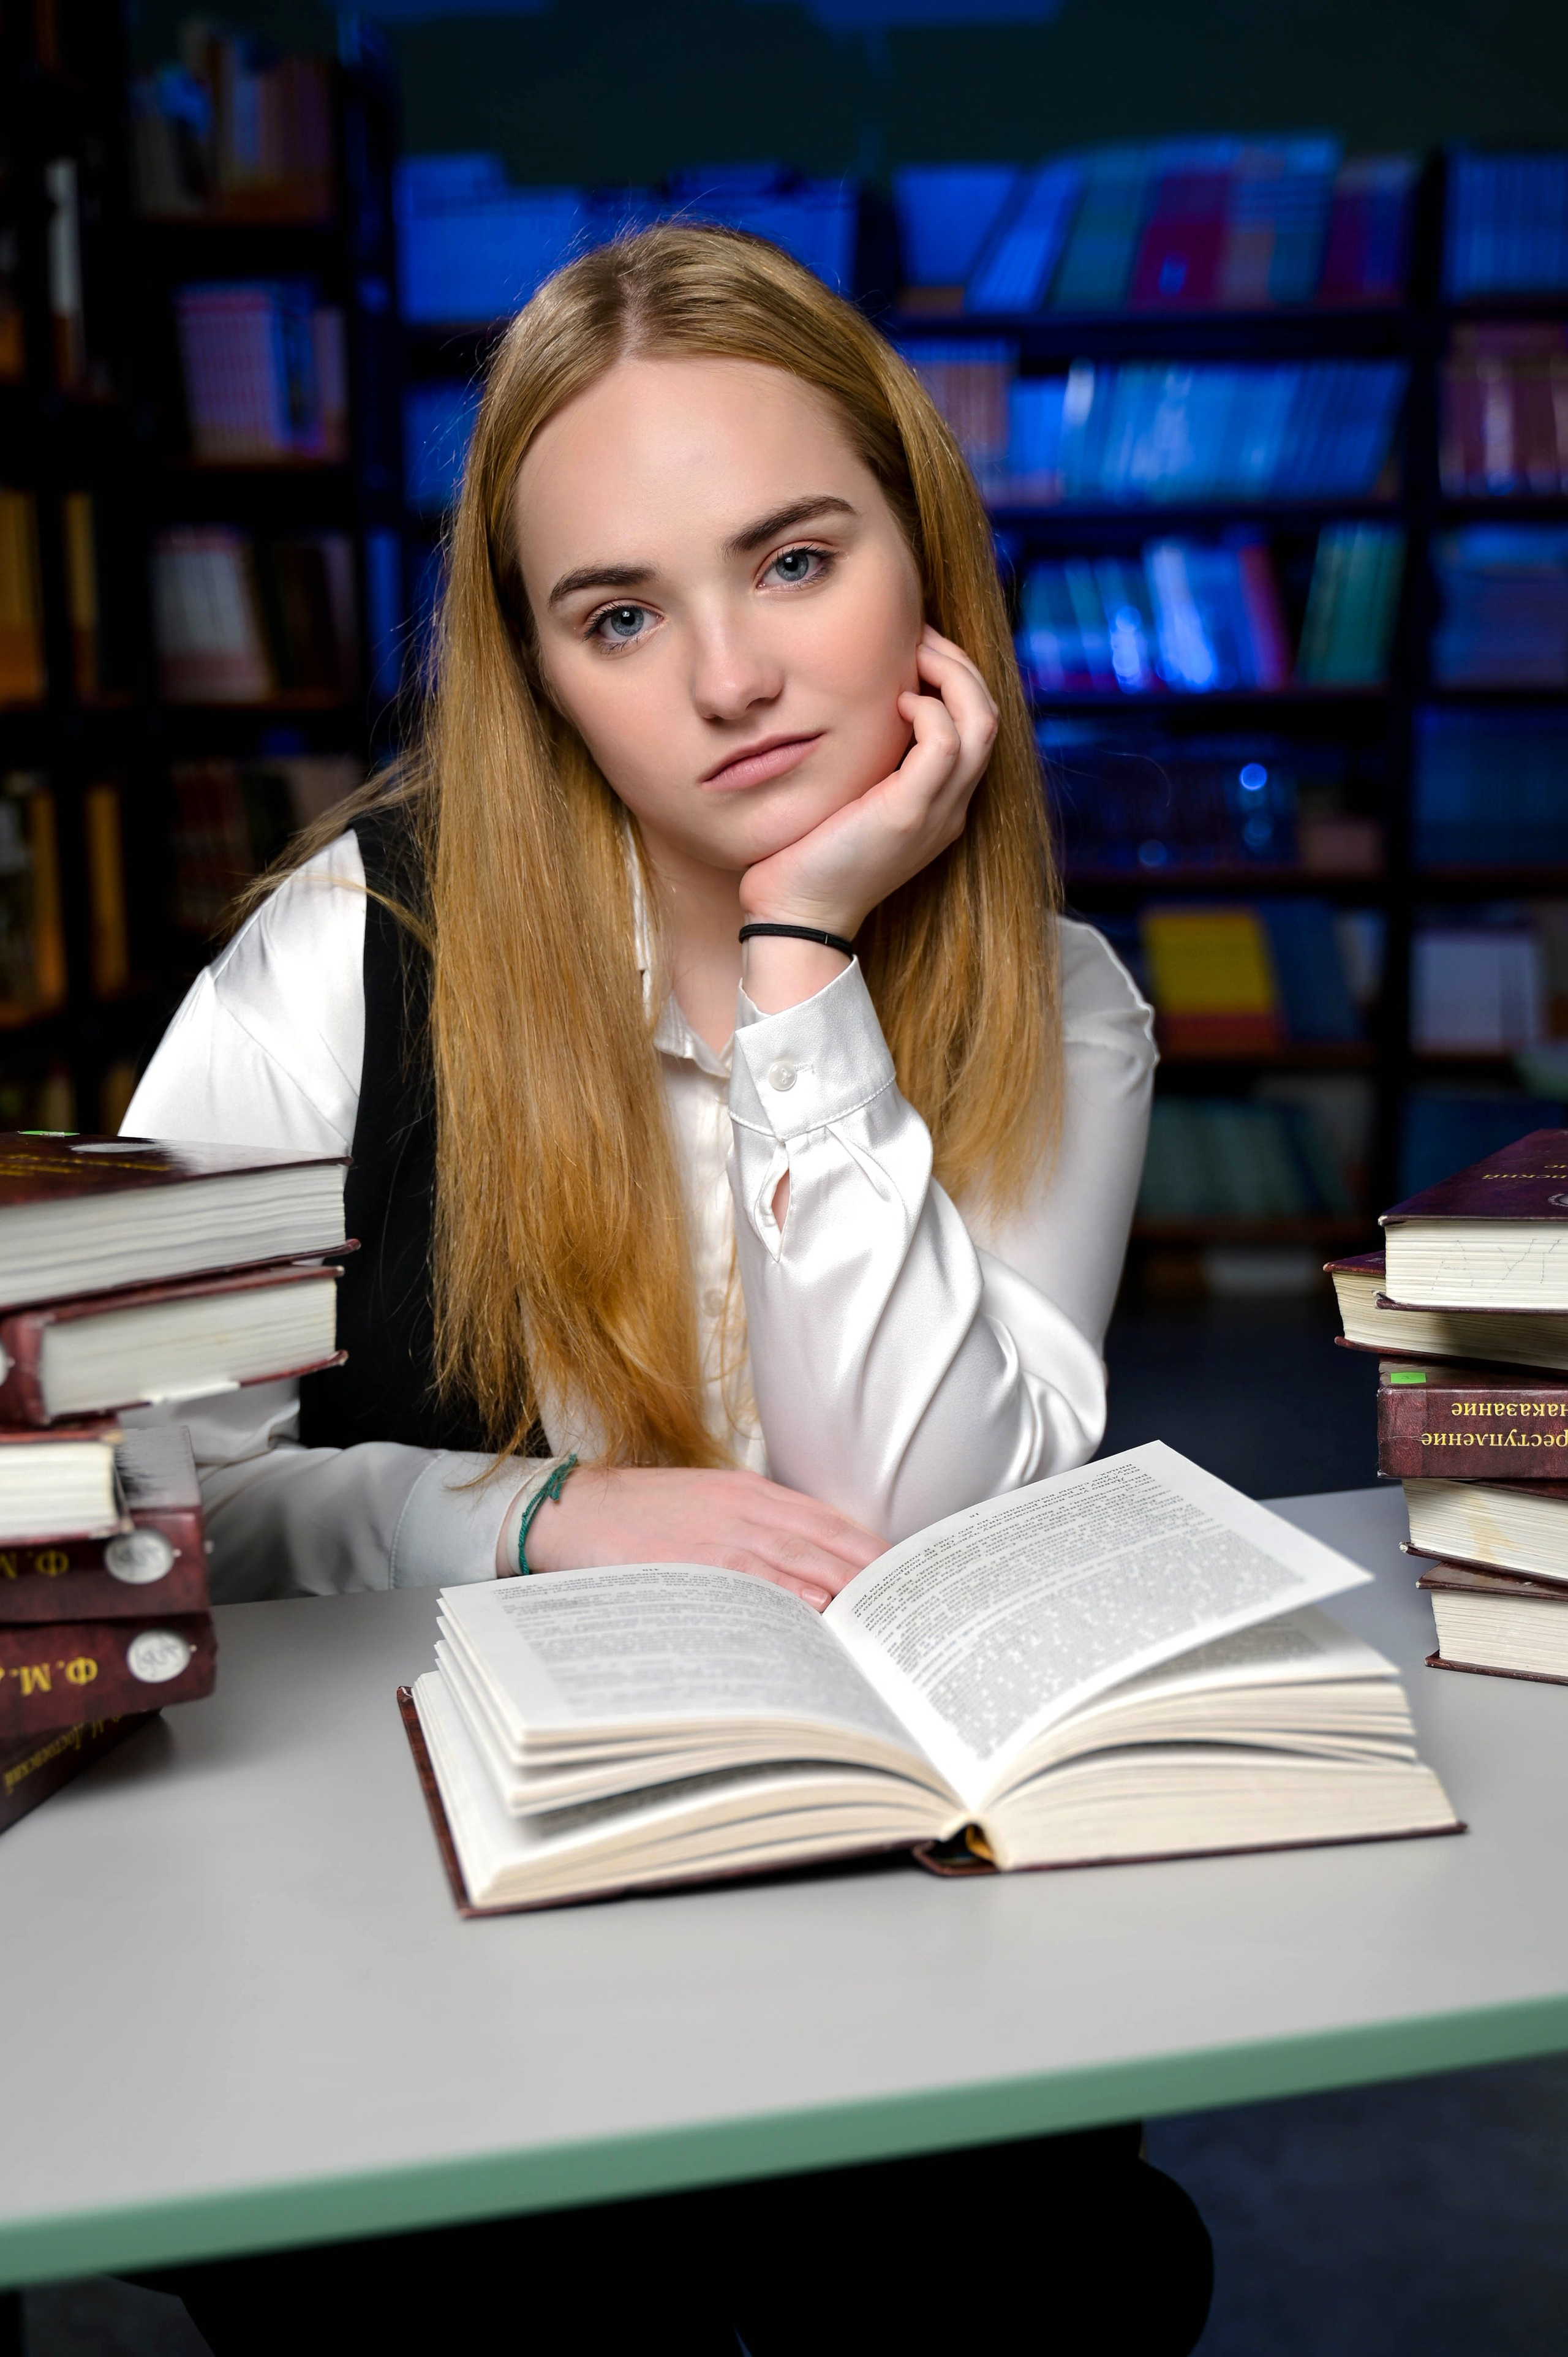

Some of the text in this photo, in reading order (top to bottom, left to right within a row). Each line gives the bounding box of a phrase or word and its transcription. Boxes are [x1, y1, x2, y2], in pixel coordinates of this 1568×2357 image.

[1421, 1429, 1568, 1447] реступление
[1095, 1463, 1133, 1477] ницах.
[1112, 1466, 1136, 1475] ему:
[1088, 1475, 1118, 1487] душу
[1091, 1477, 1125, 1490] Давно
[1117, 1474, 1147, 1485] рике.
[1123, 1479, 1156, 1491] свете!
[1058, 1482, 1088, 1494] слезы
[1066, 1489, 1090, 1498] уже
[1042, 1490, 1074, 1503] разом
[1023, 1509, 1054, 1522] вдруг
[957, 1525, 974, 1534] его
[981, 1521, 1002, 1531] ему
[1011, 1521, 1034, 1531] она,
[933, 1534, 955, 1547] глаз
[957, 1530, 972, 1539] ее.
[990, 1532, 1009, 1541] как
[940, 1531, 980, 1552] чувство
[882, 1553, 921, 1581] повисли
[904, 1552, 939, 1575] волной
[915, 1548, 962, 1577] навзрыд,
[895, 1579, 913, 1592] как
[862, 1576, 902, 1610] хлынуло
[850, 1595, 866, 1612] рес-
[862, 1603, 883, 1624] исте-
[864, 1597, 896, 1629] слыхав
